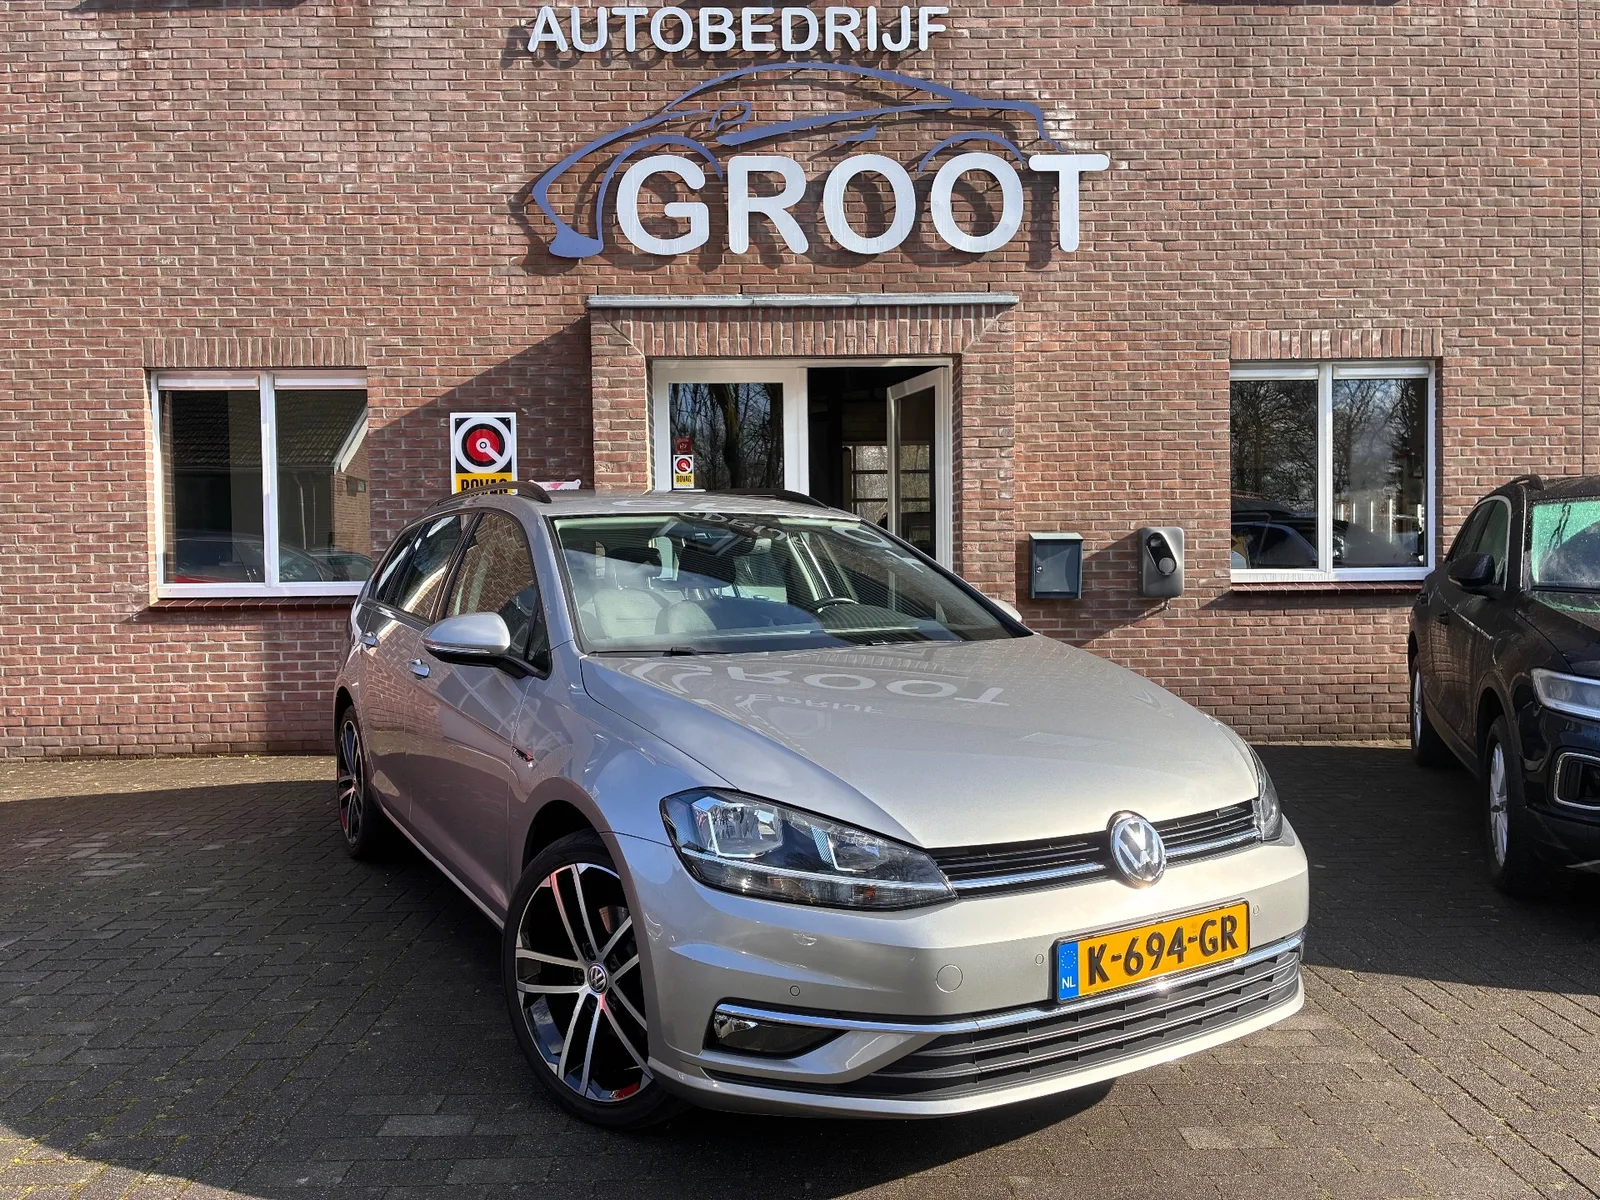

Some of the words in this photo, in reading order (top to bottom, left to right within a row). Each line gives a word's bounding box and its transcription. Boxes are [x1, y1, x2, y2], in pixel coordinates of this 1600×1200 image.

[527, 6, 950, 53] AUTOBEDRIJF
[616, 152, 1110, 256] GROOT
[676, 475, 692, 483] BOVAG
[1087, 914, 1239, 986] K-694-GR
[1061, 976, 1076, 990] NL
